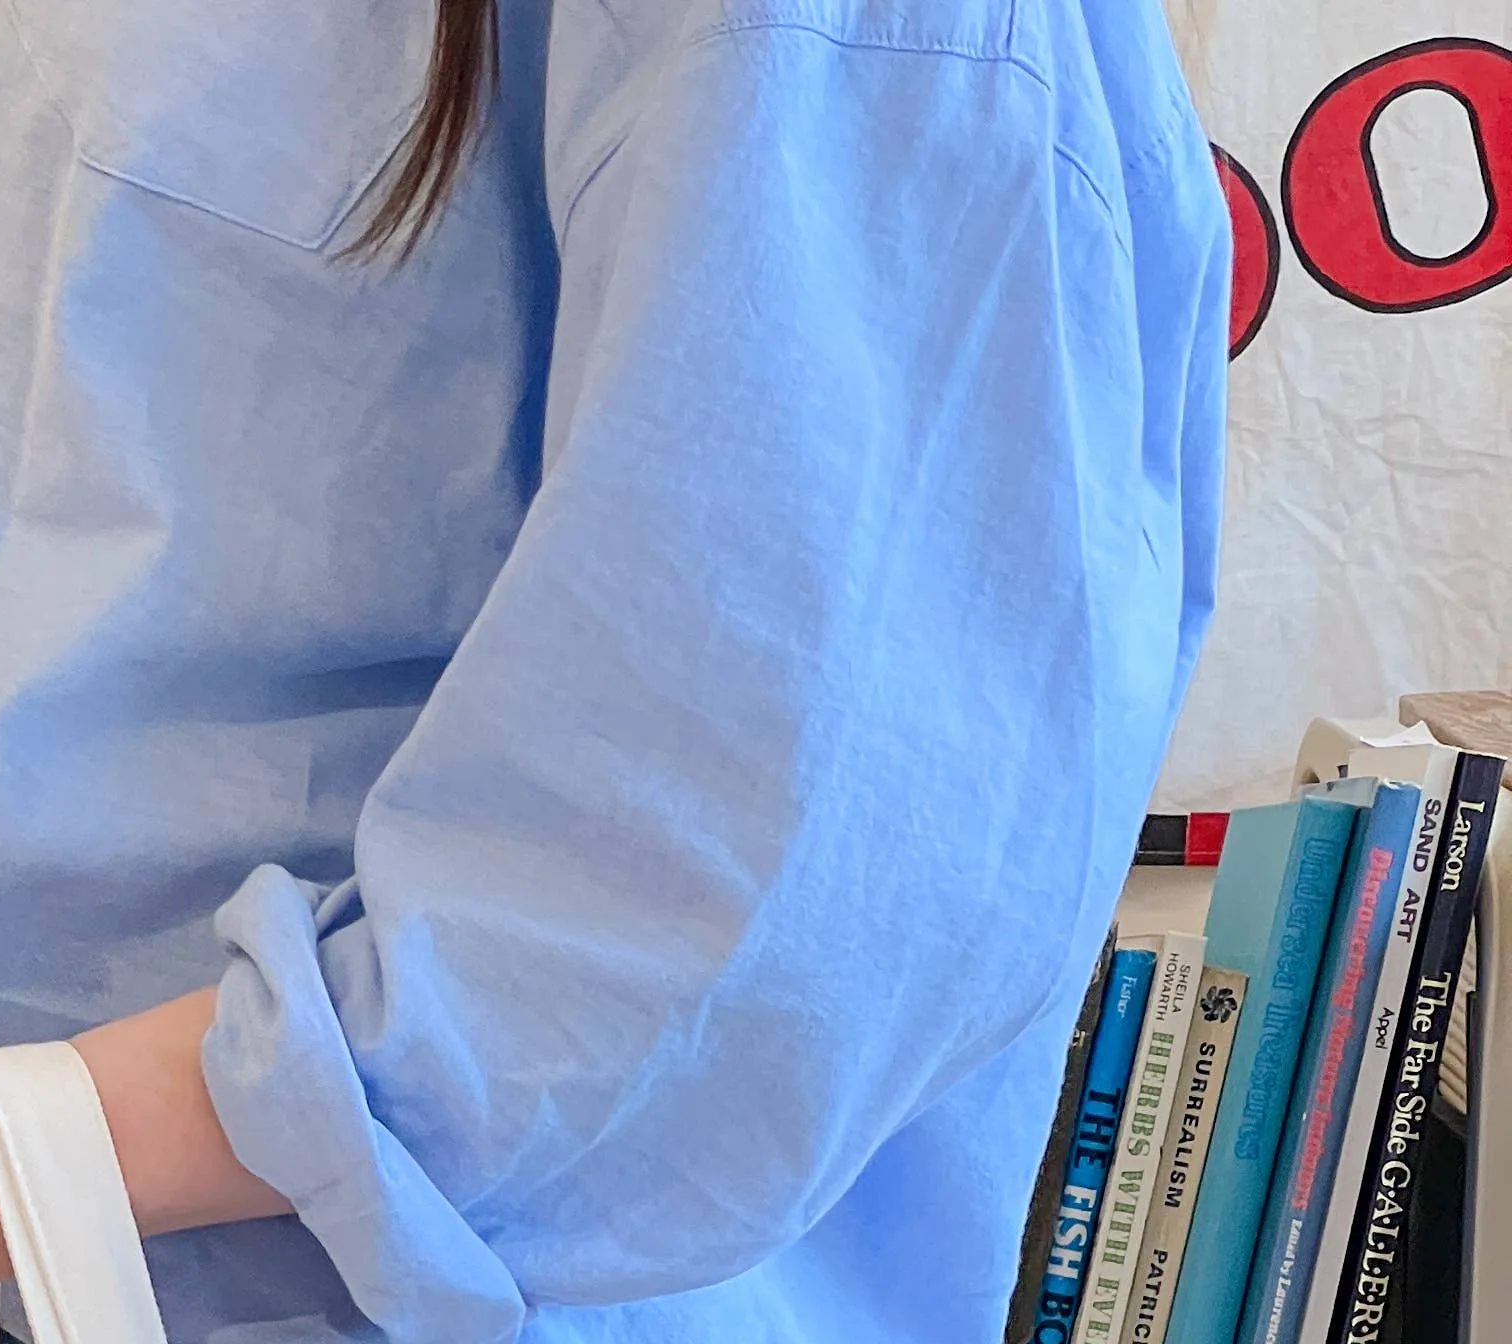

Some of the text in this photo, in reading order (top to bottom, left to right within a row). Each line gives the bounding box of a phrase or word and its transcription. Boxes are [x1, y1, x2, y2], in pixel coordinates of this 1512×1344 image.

[1397, 798, 1442, 944] SAND ART
[1440, 799, 1486, 893] Larson
[1155, 952, 1180, 1022] HOWARTH
[1171, 963, 1192, 1014] SHEILA
[1375, 1006, 1396, 1051] Appel
[1074, 1087, 1121, 1170] THE
[1127, 1031, 1175, 1157] HERBS
[1164, 1040, 1216, 1209] SURREALISM
[1045, 1184, 1097, 1280] FISH
[1101, 1168, 1144, 1265] WITH
